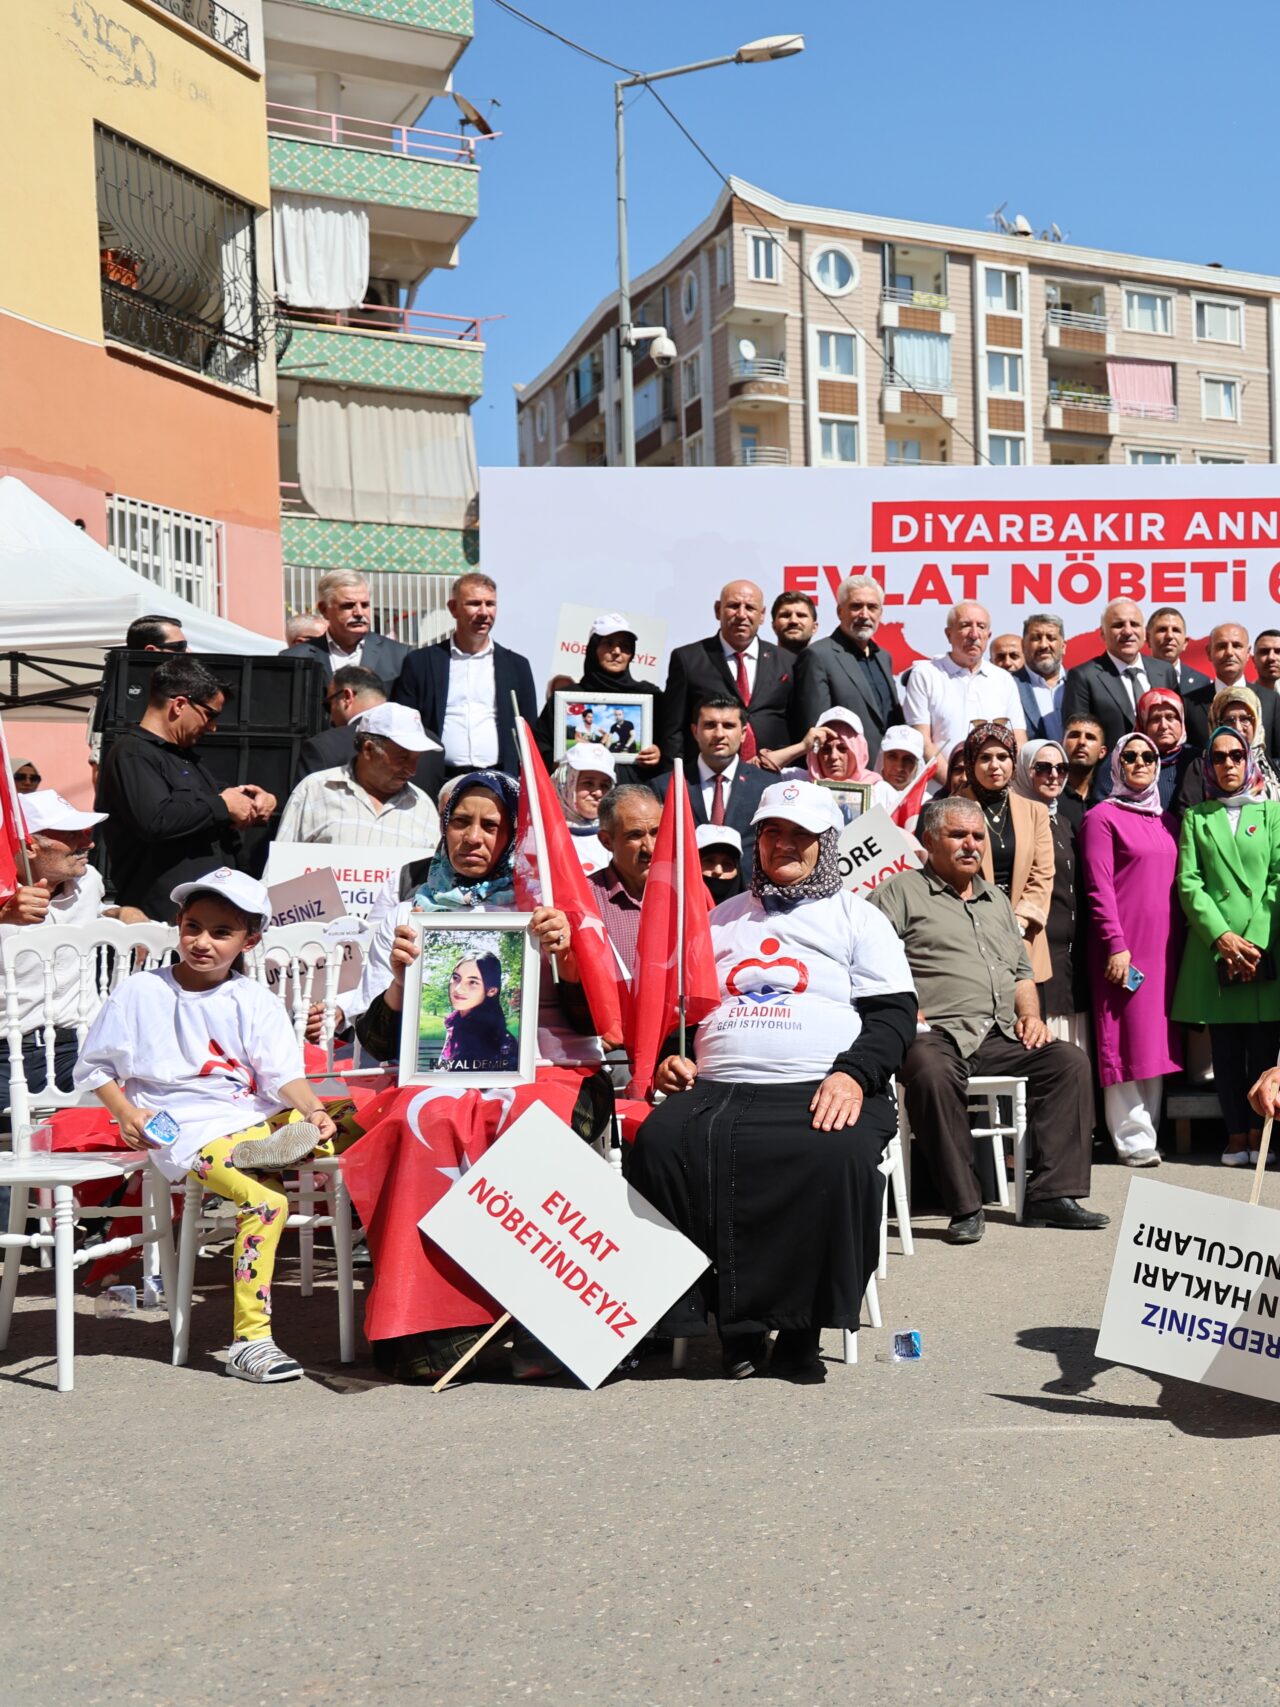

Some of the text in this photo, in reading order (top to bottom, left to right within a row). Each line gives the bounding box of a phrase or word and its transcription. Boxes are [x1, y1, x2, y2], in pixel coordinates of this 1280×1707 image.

[837, 835, 883, 877] ÖRE
[717, 1017, 802, 1031] GERİ İSTİYORUM
[728, 1006, 791, 1018] EVLADIMI
[540, 1190, 621, 1263] EVLAT
[467, 1176, 638, 1340] NÖBETİNDEYİZ
[1133, 1261, 1252, 1312] HAKLARI
